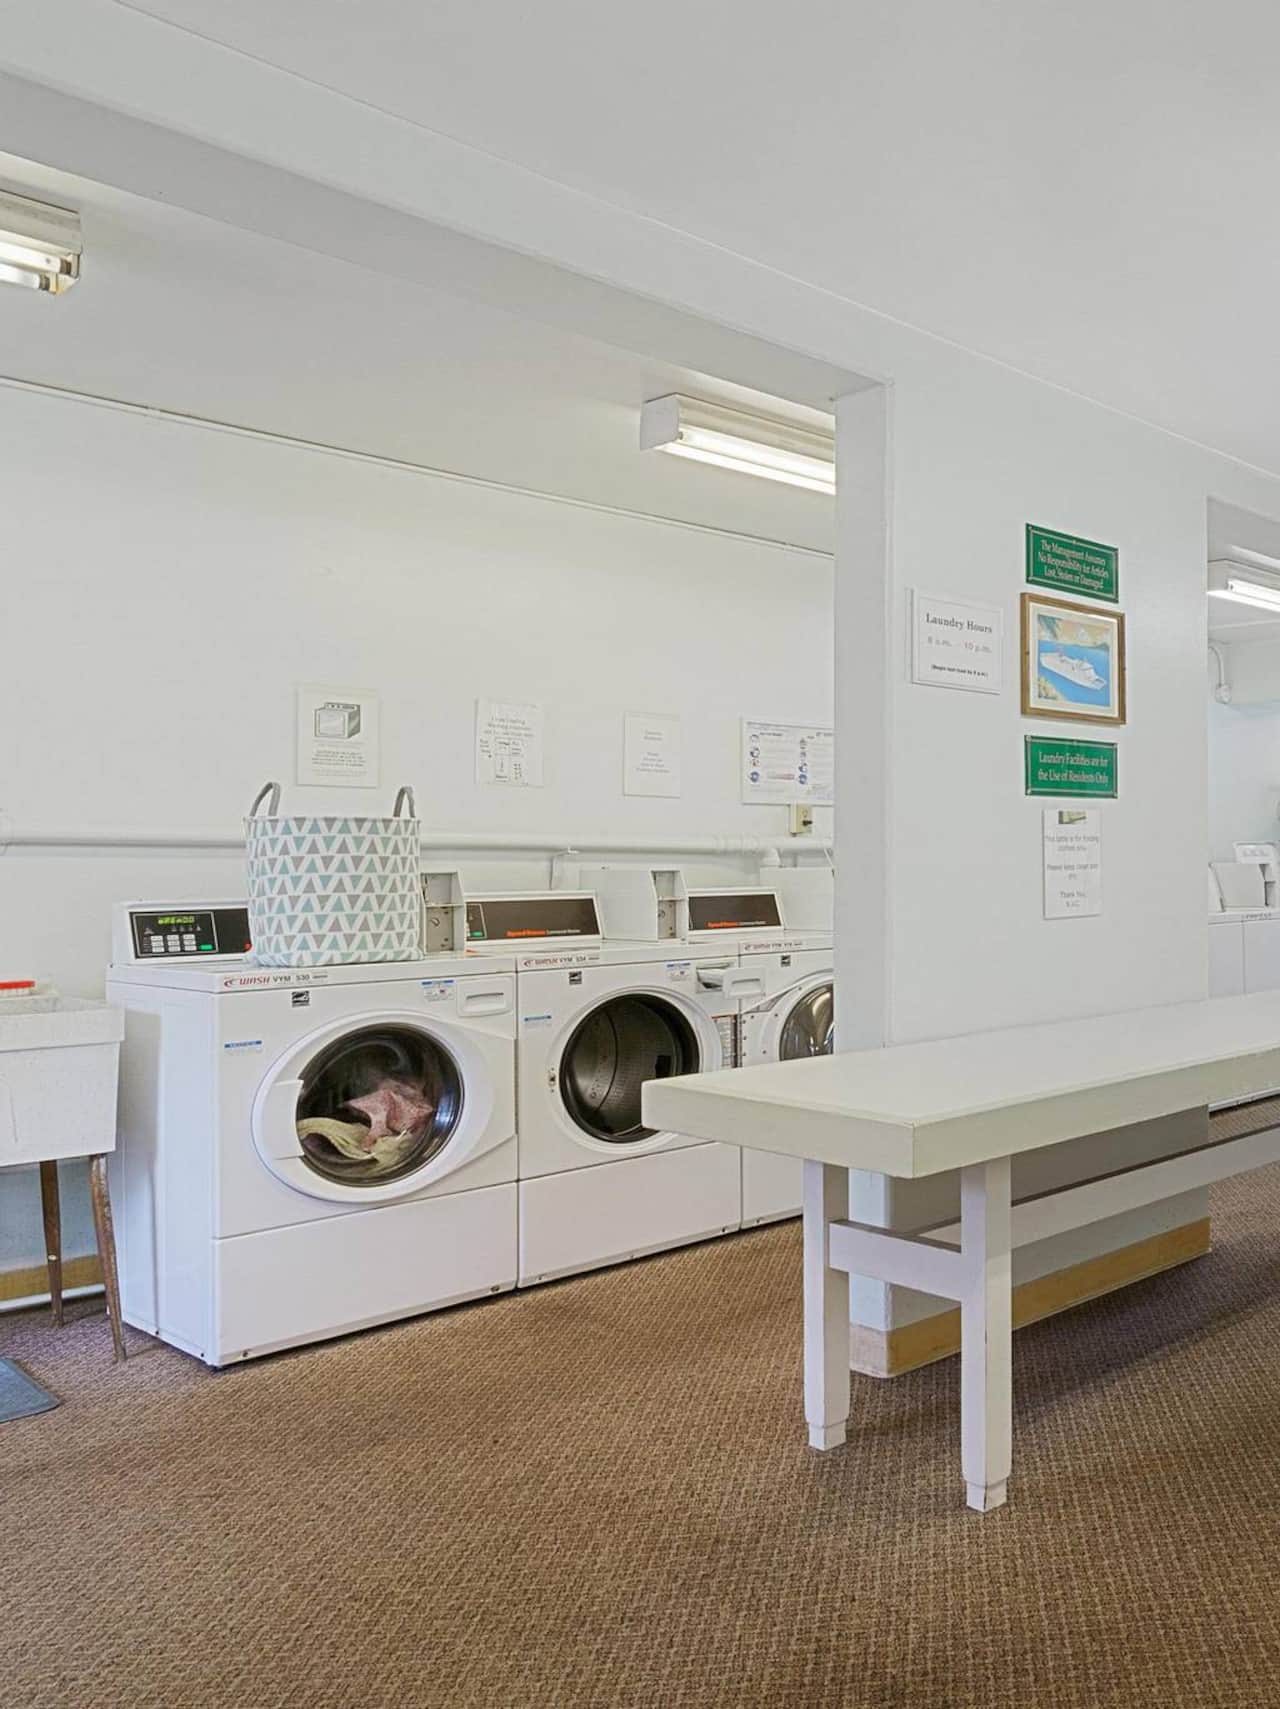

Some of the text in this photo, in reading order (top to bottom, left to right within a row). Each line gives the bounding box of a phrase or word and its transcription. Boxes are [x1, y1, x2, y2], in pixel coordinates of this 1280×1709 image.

[1041, 539, 1052, 552] The
[1052, 543, 1084, 559] Management
[1038, 551, 1109, 579] No Responsibility for Articles
[1056, 568, 1073, 580] Stolen
[1074, 575, 1080, 583] or
[926, 612, 992, 632] Laundry Hours
[964, 641, 974, 651] 10
[1039, 752, 1065, 768] Laundry
[1065, 753, 1090, 766] Facilities
[1099, 756, 1108, 767] for
[1038, 768, 1109, 787] the Use of Residents Only
